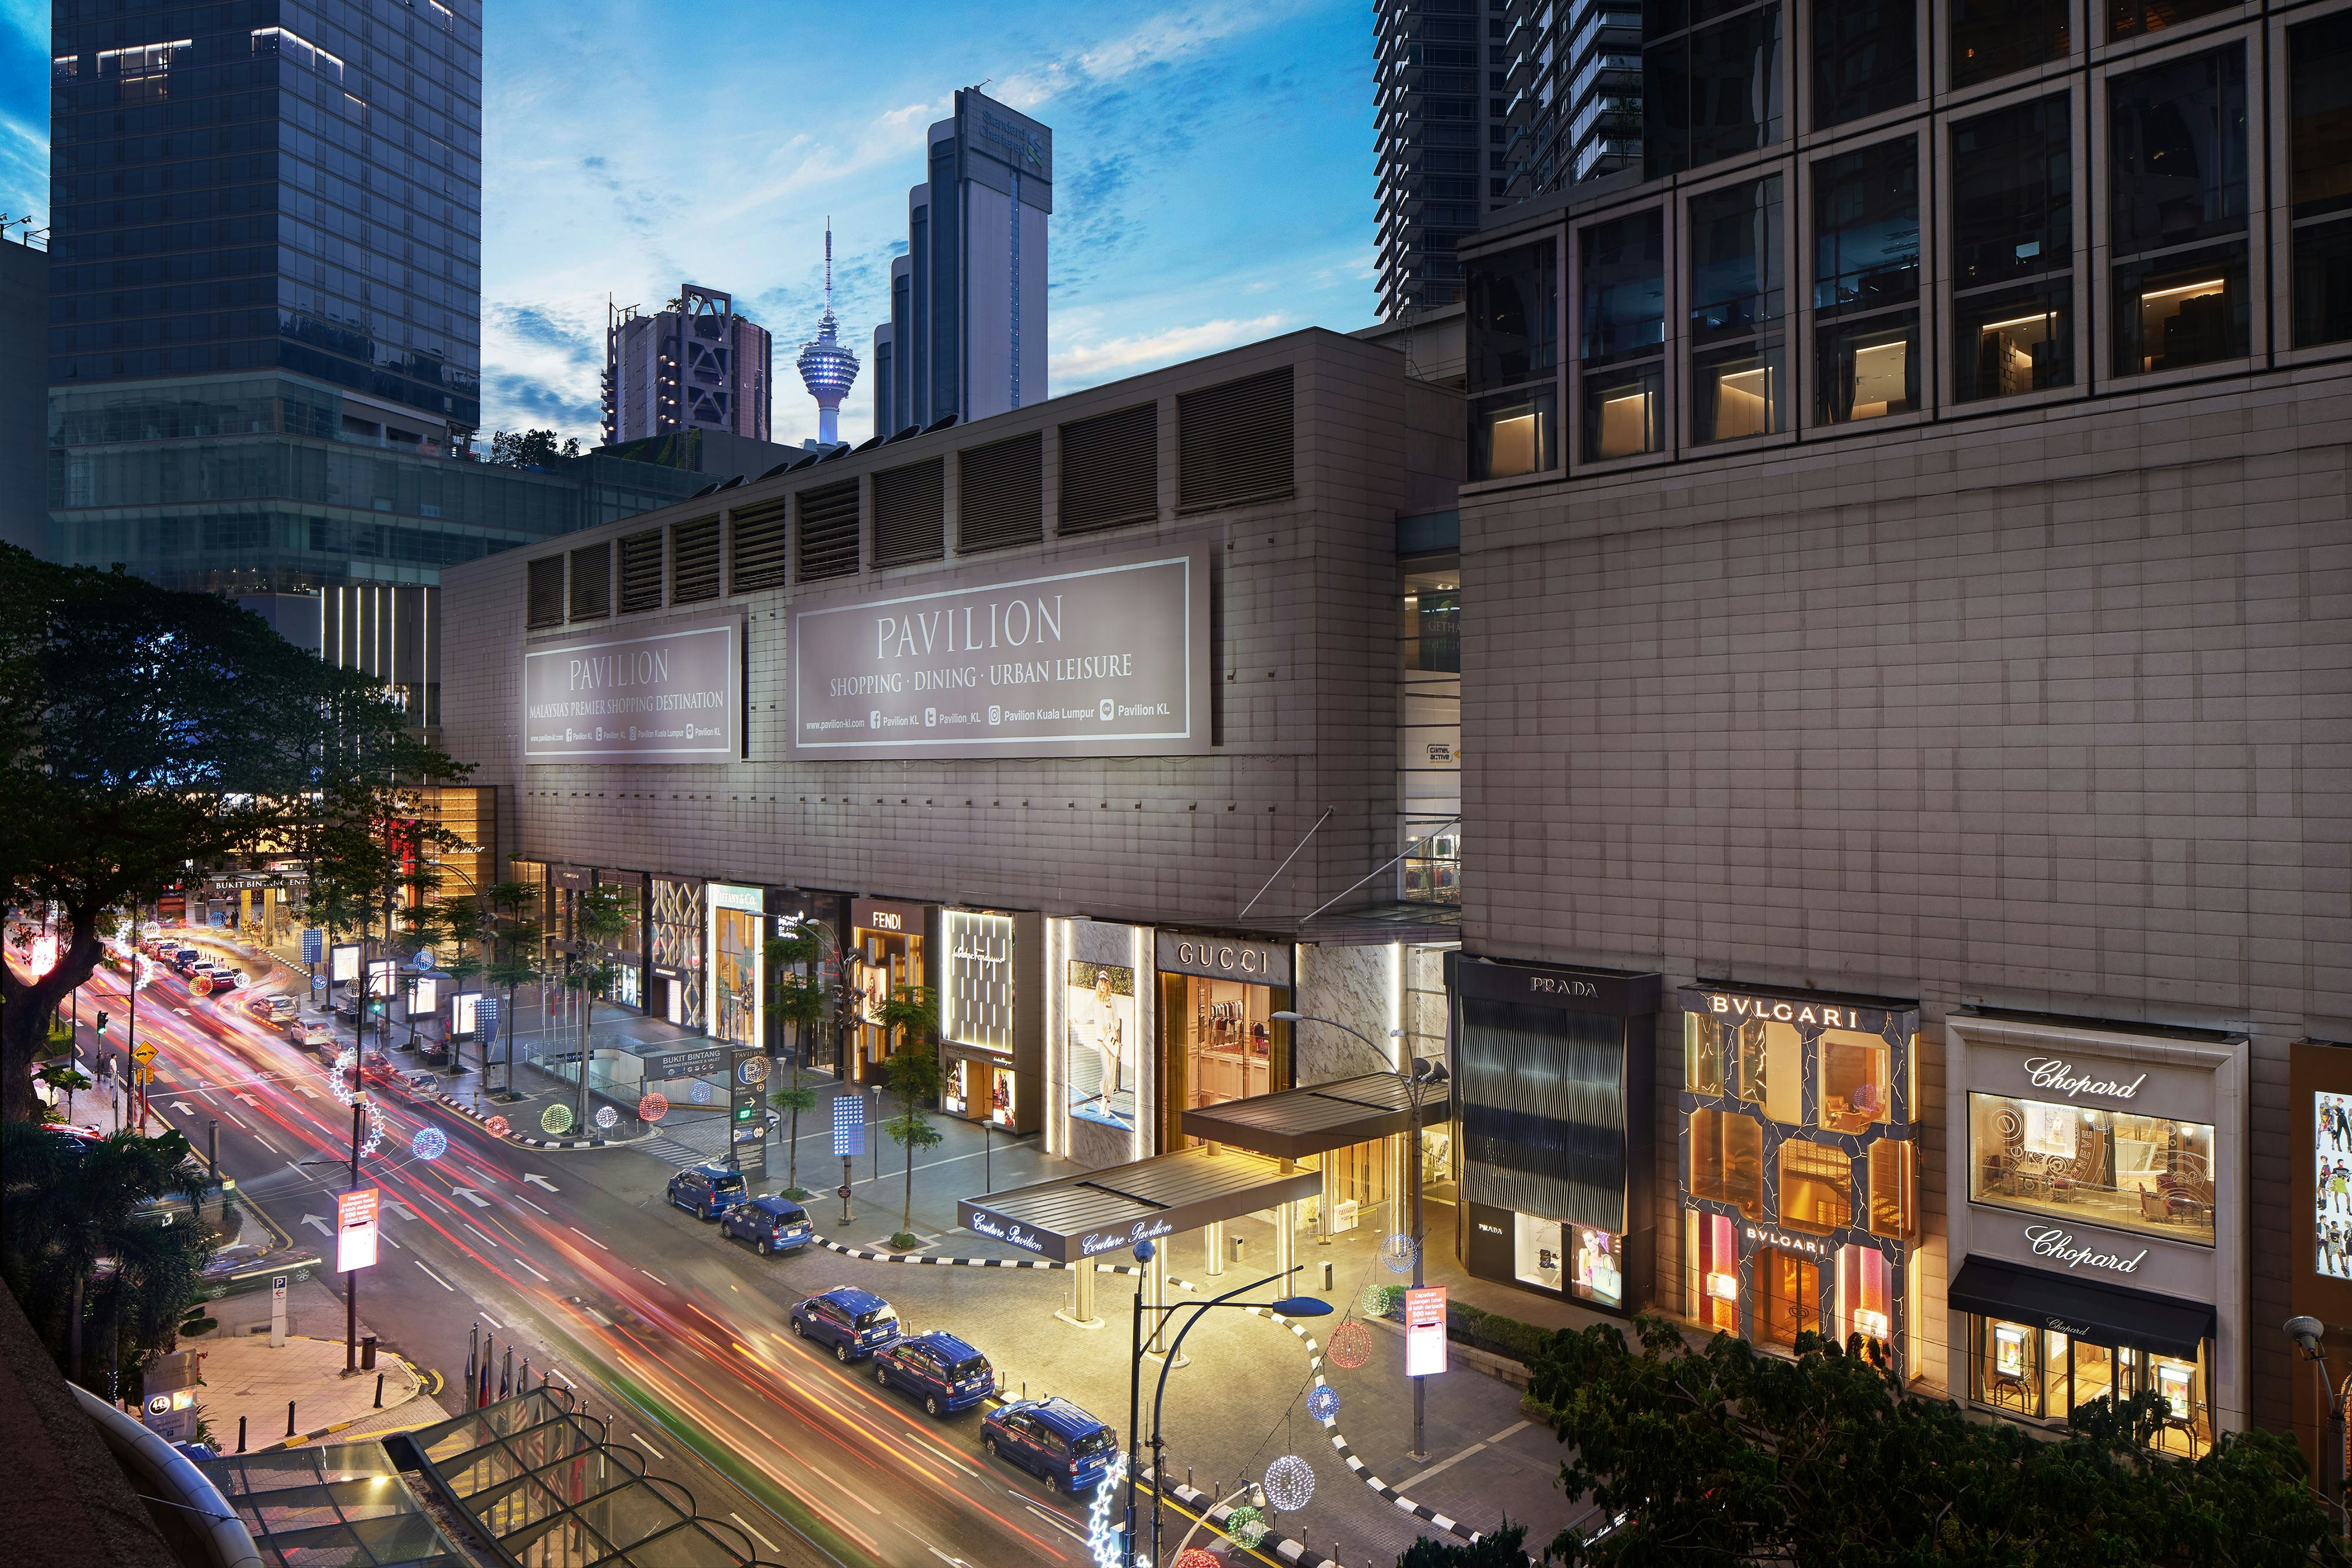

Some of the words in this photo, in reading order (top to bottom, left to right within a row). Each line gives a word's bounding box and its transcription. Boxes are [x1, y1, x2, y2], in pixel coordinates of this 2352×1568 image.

[979, 123, 1025, 156] Chartered
[983, 110, 1025, 141] Standard
[876, 595, 1063, 659] PAVILION
[570, 649, 668, 691] PAVILION
[830, 673, 902, 697] SHOPPING
[914, 667, 976, 691] DINING
[990, 659, 1050, 685] URBAN
[1056, 654, 1132, 681] LEISURE
[530, 702, 569, 719] MALAYSIA'S
[571, 699, 606, 717] PREMIER
[607, 696, 653, 714] SHOPPING
[656, 691, 723, 711] DESTINATION
[806, 718, 865, 731] www.pavilion-kl.com
[883, 716, 908, 727] Pavilion
[910, 715, 919, 725] KL
[939, 713, 981, 725] Pavilion_KL
[1004, 710, 1034, 721] Pavilion
[1037, 709, 1060, 720] Kuala
[1062, 708, 1095, 721] Lumpur
[1118, 704, 1154, 717] Pavilion
[1157, 703, 1170, 716] KL
[573, 733, 587, 741] Pavilion
[638, 730, 654, 738] Pavilion
[654, 730, 667, 738] Kuala
[667, 729, 684, 738] Lumpur
[695, 728, 713, 736] Pavilion
[714, 727, 721, 735] KL
[873, 911, 901, 930] FENDI
[1178, 942, 1266, 974] GUCCI
[1530, 977, 1599, 998] PRADA
[1713, 997, 1857, 1028] BVLGARI
[663, 1055, 686, 1064] BUKIT
[687, 1050, 720, 1060] BINTANG
[2024, 1057, 2148, 1098] Chopard
[973, 1212, 1005, 1238] Couture
[1007, 1225, 1044, 1252] Pavilion
[1082, 1233, 1125, 1255] Couture
[1128, 1219, 1172, 1243] Pavilion
[1478, 1223, 1503, 1235] PRADA
[1747, 1228, 1825, 1254] BVLGARI
[2024, 1225, 2149, 1273] Chopard
[276, 1279, 283, 1288] P
[2046, 1316, 2090, 1336] Chopard
